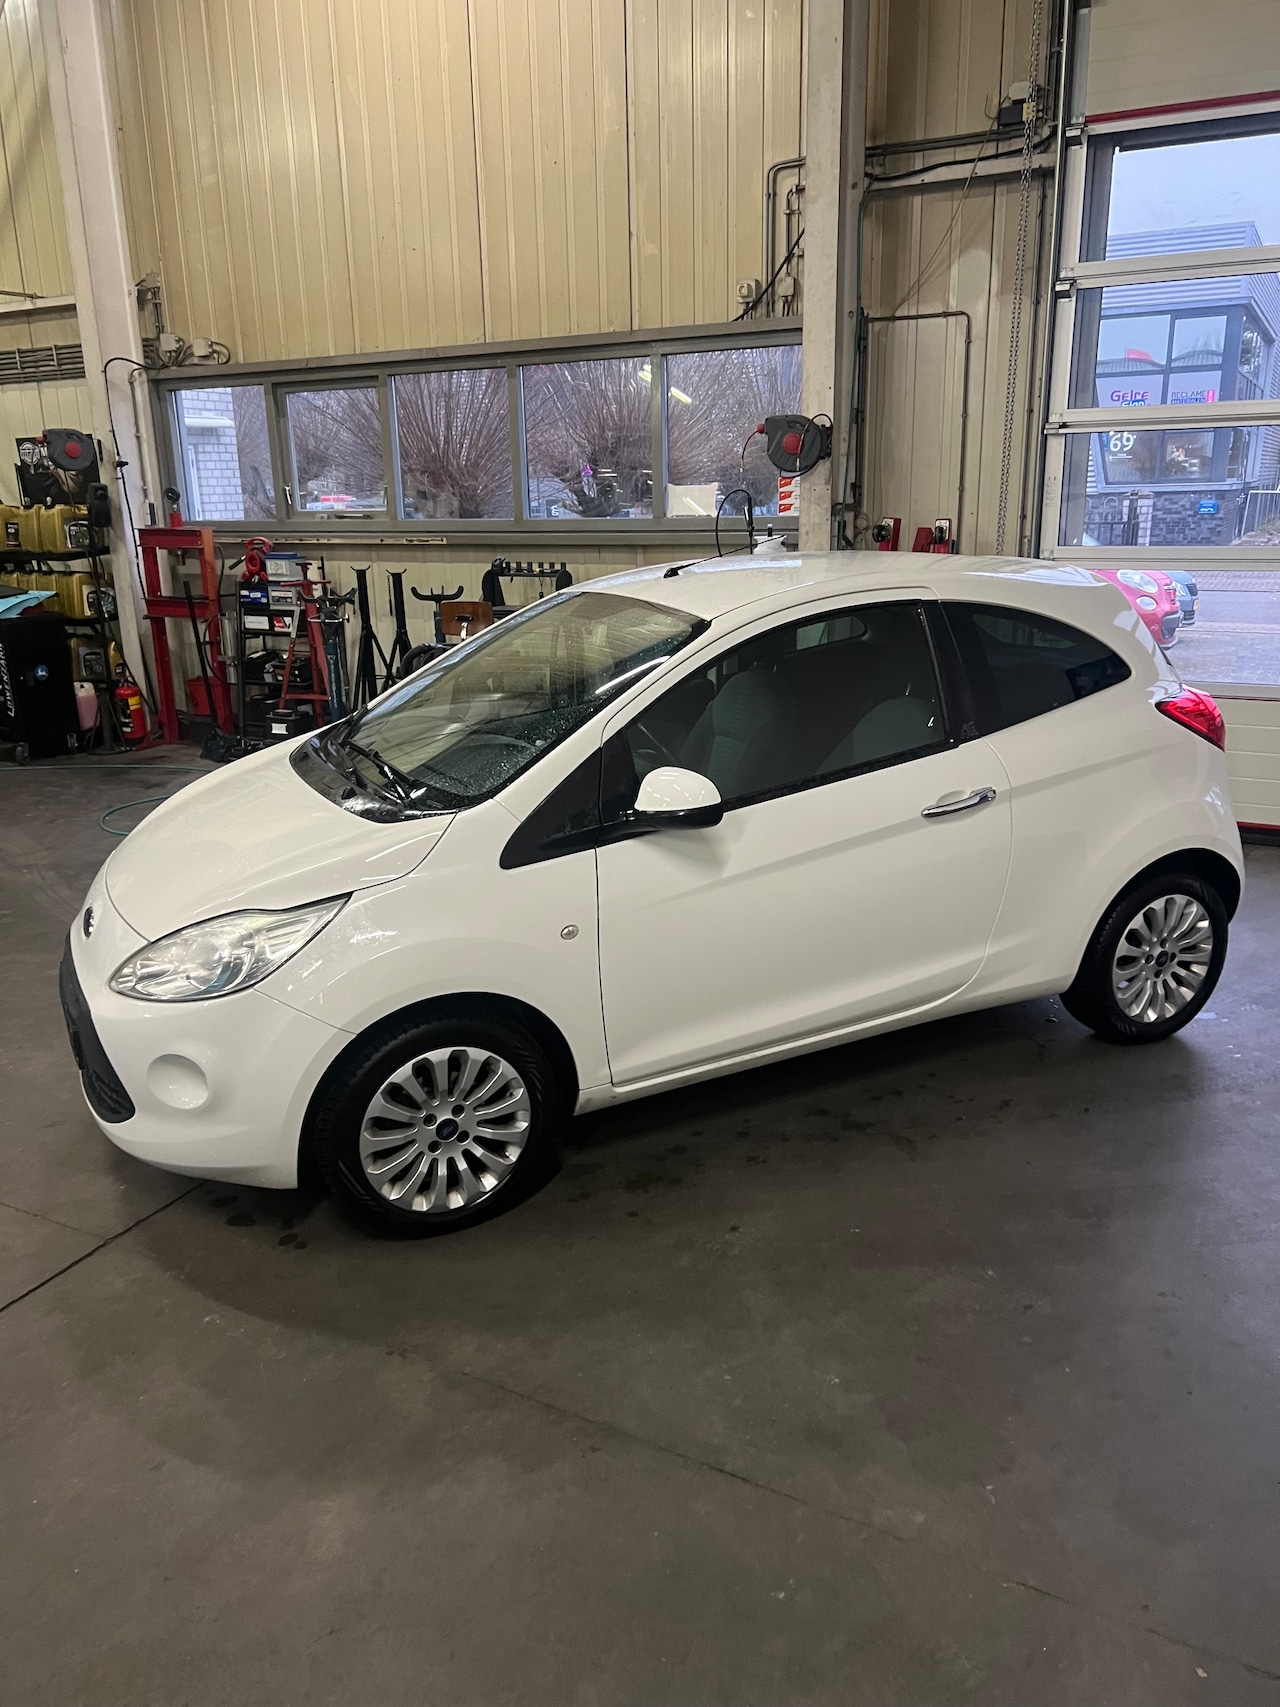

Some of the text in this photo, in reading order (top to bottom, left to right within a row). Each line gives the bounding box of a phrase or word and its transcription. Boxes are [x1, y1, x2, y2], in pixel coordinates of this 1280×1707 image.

[1111, 389, 1149, 402] Gelre
[1171, 390, 1206, 399] RECLAME
[1109, 433, 1134, 452] 69
